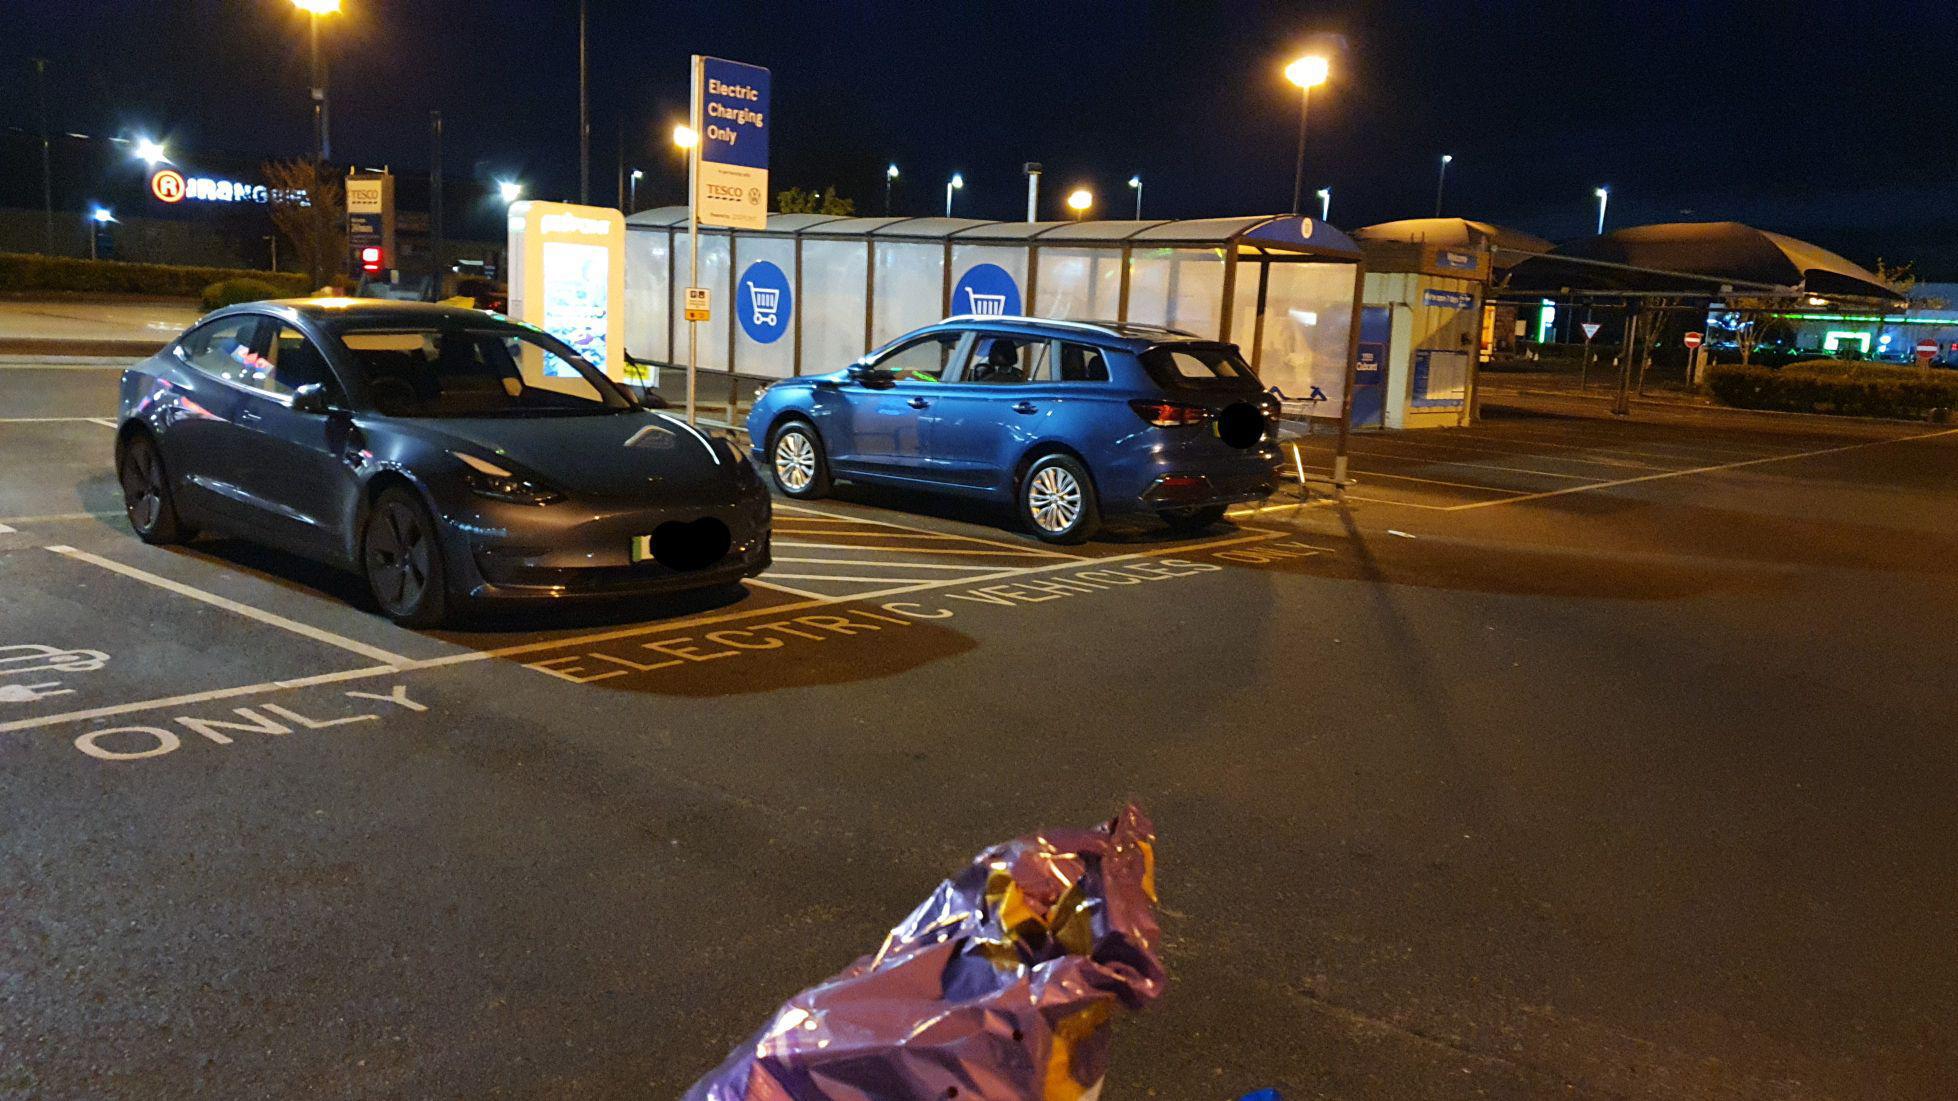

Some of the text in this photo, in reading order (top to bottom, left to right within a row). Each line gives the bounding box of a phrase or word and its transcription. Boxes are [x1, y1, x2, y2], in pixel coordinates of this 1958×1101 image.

[708, 78, 758, 101] Electric
[707, 102, 763, 128] Charging
[707, 125, 737, 146] Only
[350, 189, 379, 200] TESCO
[706, 183, 743, 198] TESCO
[521, 541, 1336, 684] ELECTRIC VEHICLES ONLY
[74, 685, 430, 760] ONLY
